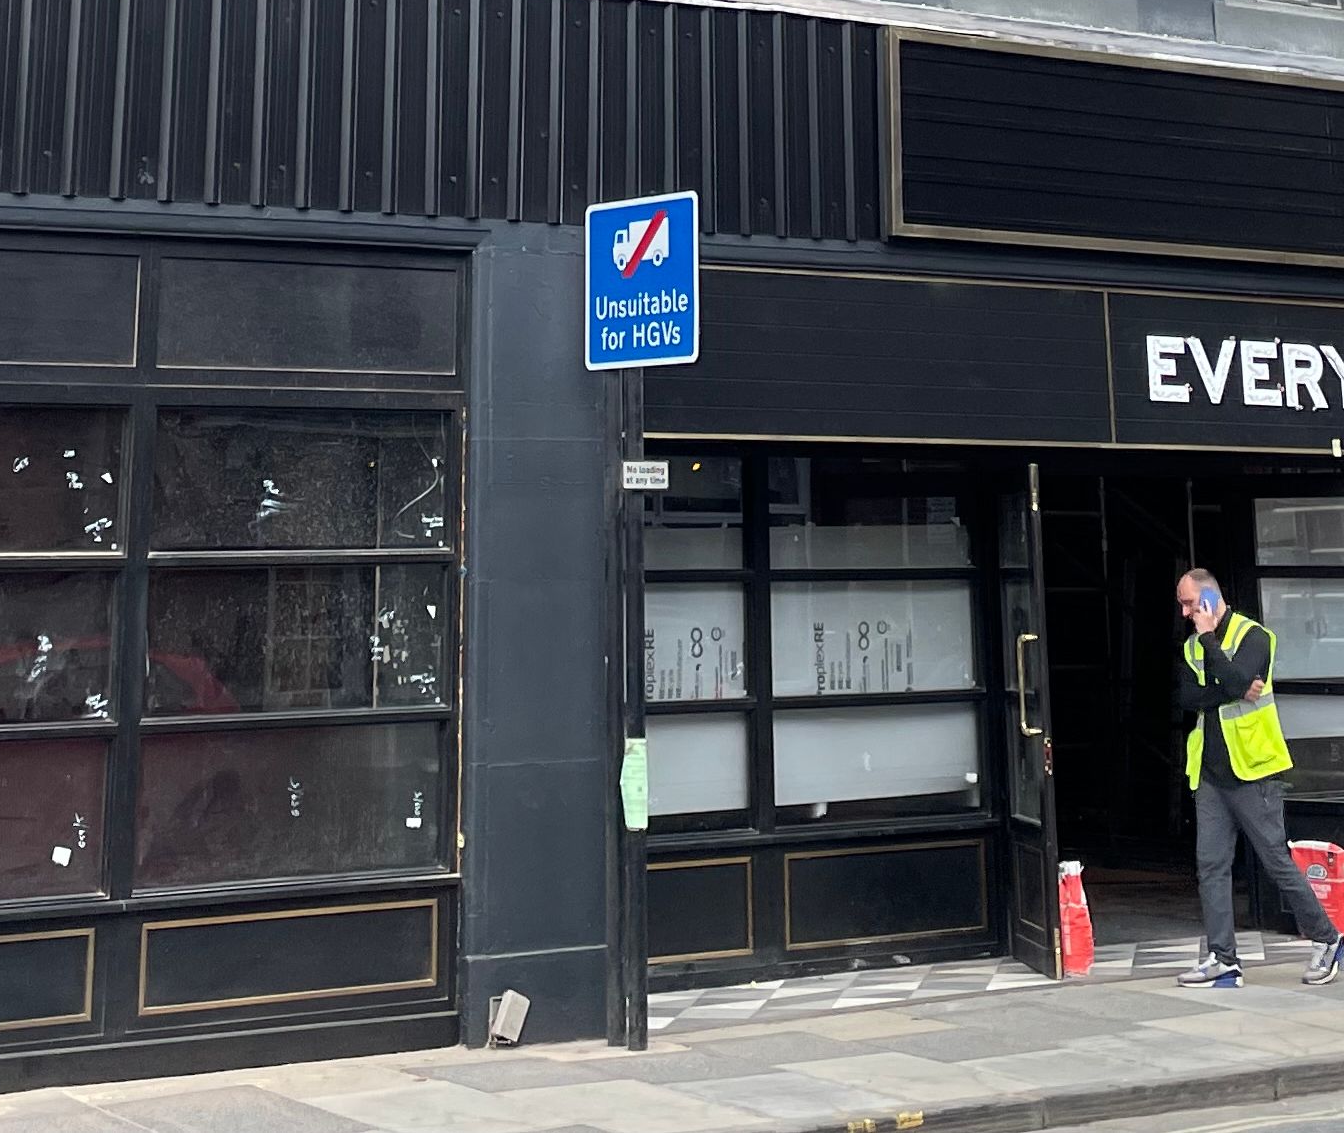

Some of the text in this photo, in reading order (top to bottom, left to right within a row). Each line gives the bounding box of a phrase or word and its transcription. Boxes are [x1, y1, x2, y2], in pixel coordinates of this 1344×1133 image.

[595, 289, 689, 320] Unsuitable
[601, 320, 681, 350] for HGVs
[639, 465, 665, 475] loading
[626, 476, 665, 485] at any time
